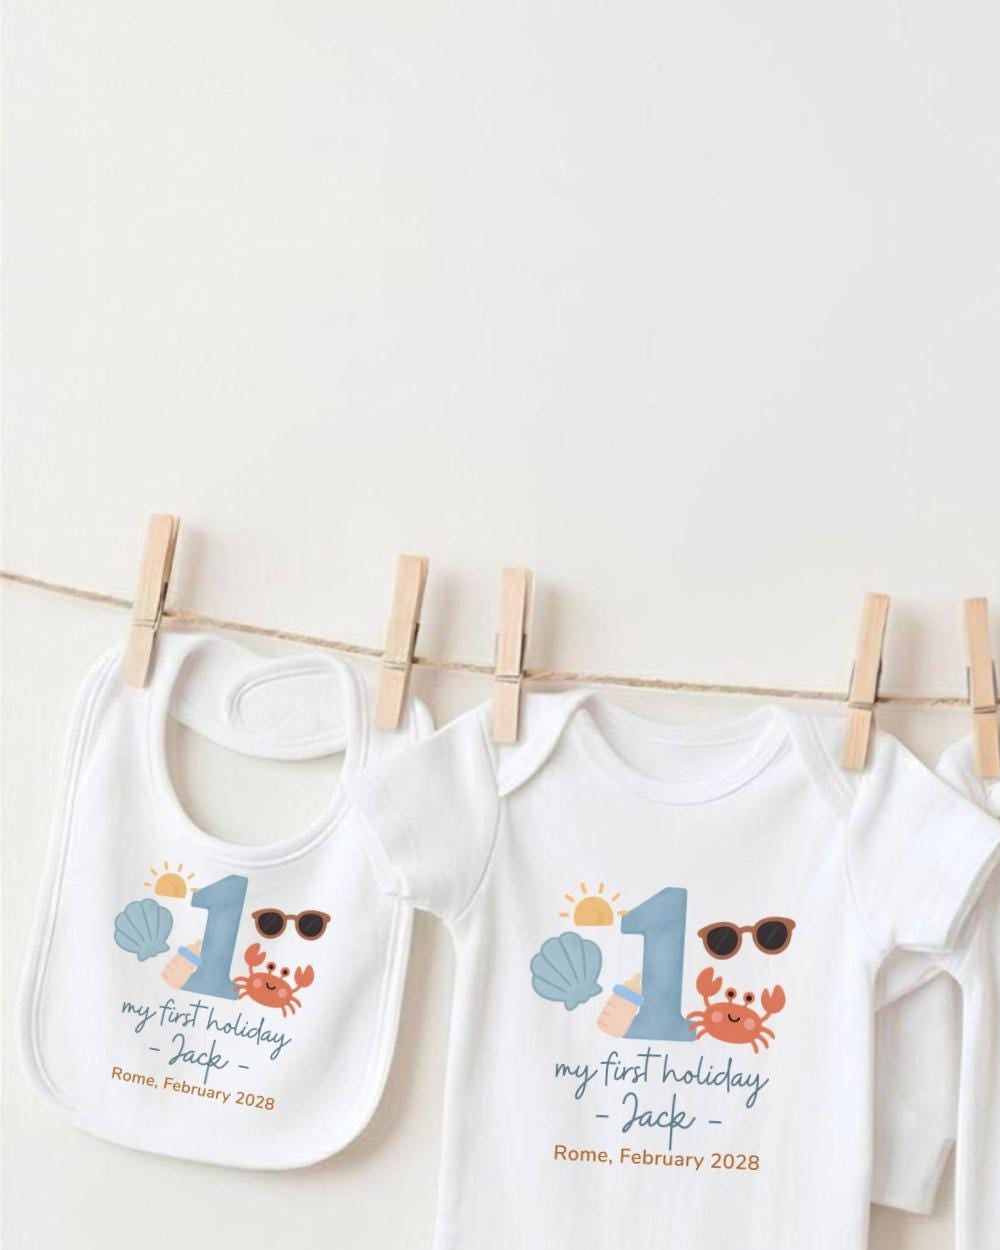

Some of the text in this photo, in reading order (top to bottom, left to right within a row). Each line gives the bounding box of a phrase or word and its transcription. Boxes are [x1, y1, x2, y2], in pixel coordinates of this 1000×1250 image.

[180, 874, 249, 1001] 1
[620, 887, 697, 1042] 1
[121, 998, 292, 1060] my first holiday
[168, 1033, 229, 1085] Jack
[111, 1066, 275, 1110] Rome, February 2028
[555, 1047, 769, 1109] my first holiday
[622, 1092, 696, 1151] Jack
[553, 1145, 760, 1171] Rome, February 2028
